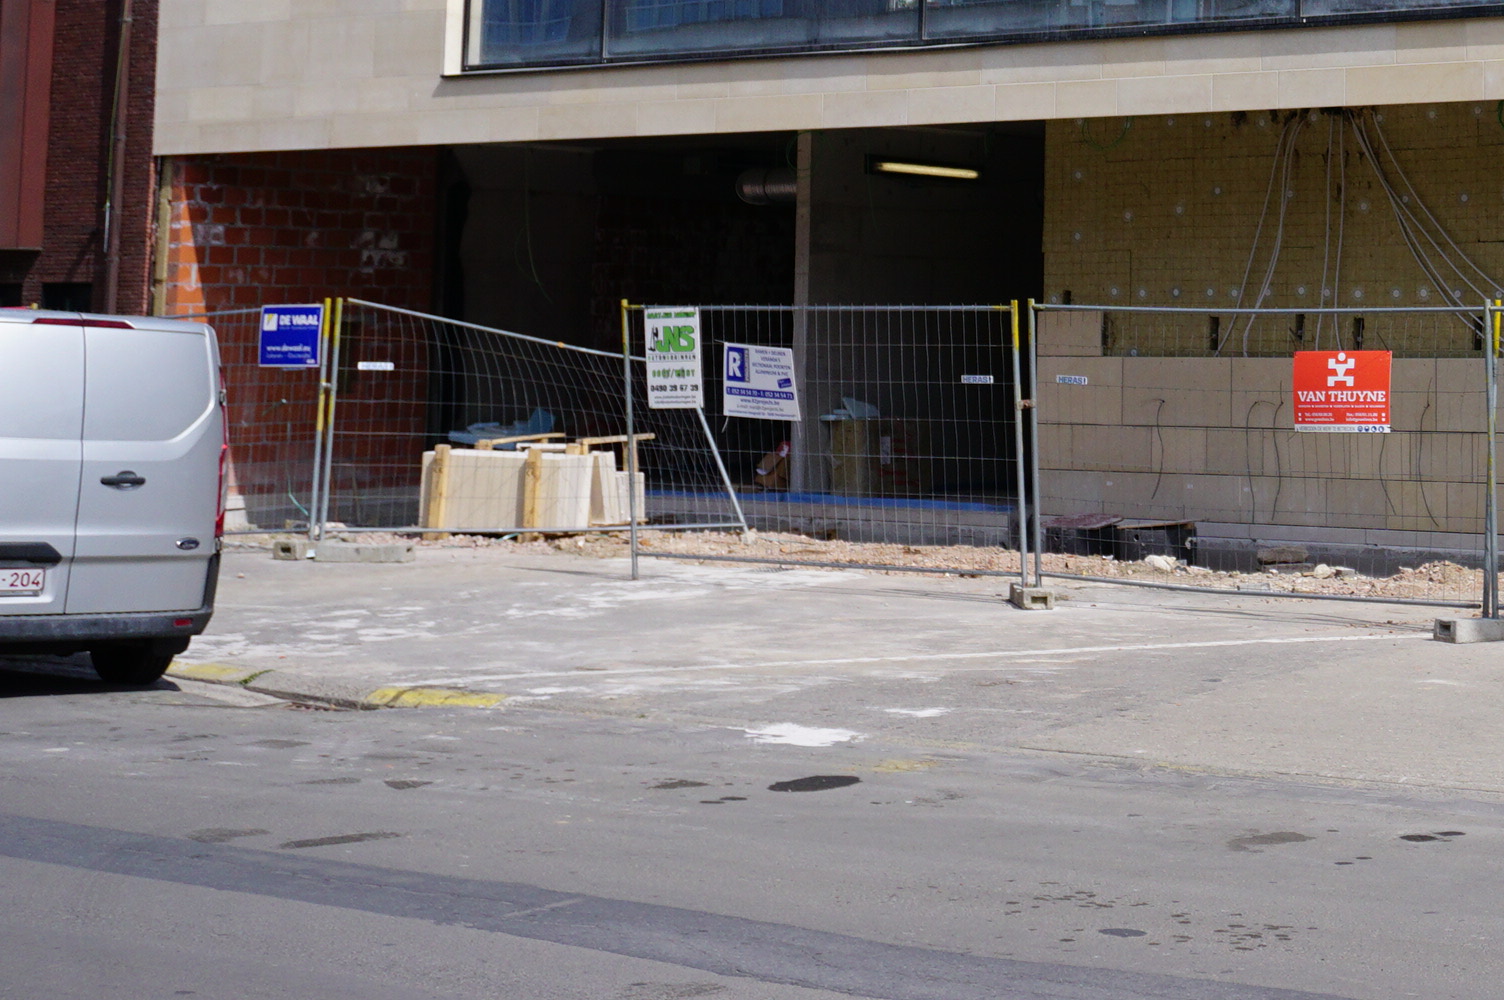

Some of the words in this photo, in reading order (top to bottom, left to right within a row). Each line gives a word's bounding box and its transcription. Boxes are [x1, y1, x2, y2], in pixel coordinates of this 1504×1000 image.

[279, 314, 291, 326] DE
[292, 314, 318, 326] WAAL
[656, 326, 695, 352] JNS
[1298, 390, 1326, 402] VAN
[1328, 390, 1386, 402] THUYNE
